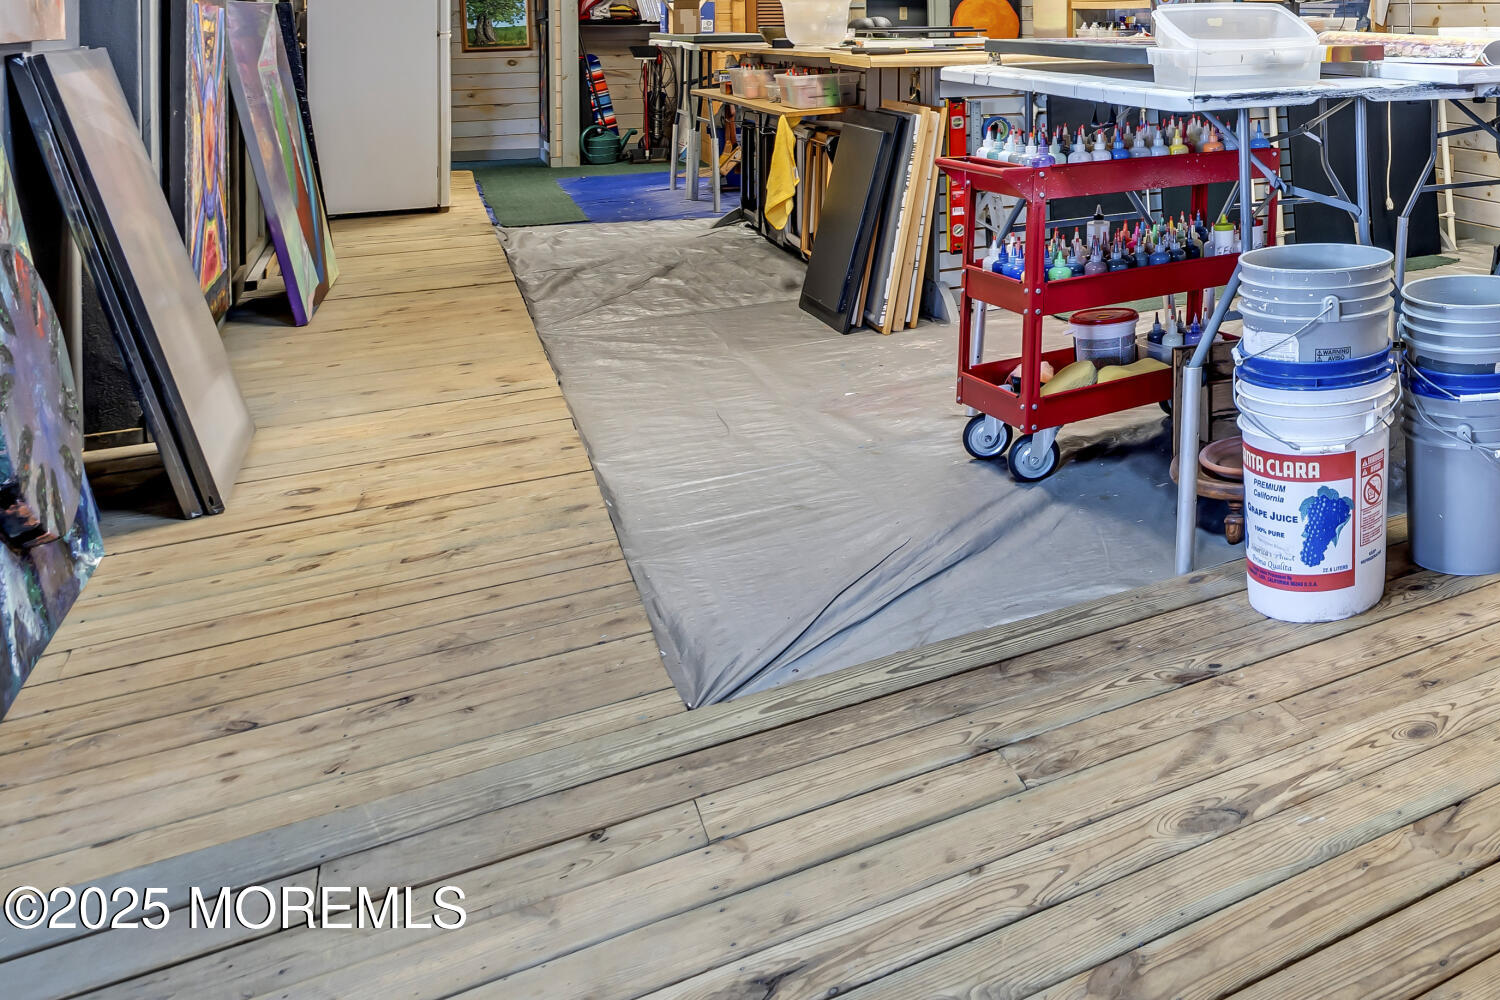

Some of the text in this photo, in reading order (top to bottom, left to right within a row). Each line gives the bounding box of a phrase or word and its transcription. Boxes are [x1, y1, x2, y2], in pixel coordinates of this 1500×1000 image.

[1322, 348, 1350, 356] WARNING
[1243, 446, 1320, 479] ANTA CLARA
[1253, 479, 1286, 493] PREMIUM
[1253, 489, 1285, 503] California
[1248, 502, 1298, 524] GRAPE JUICE
[1254, 525, 1285, 539] 100% PURE
